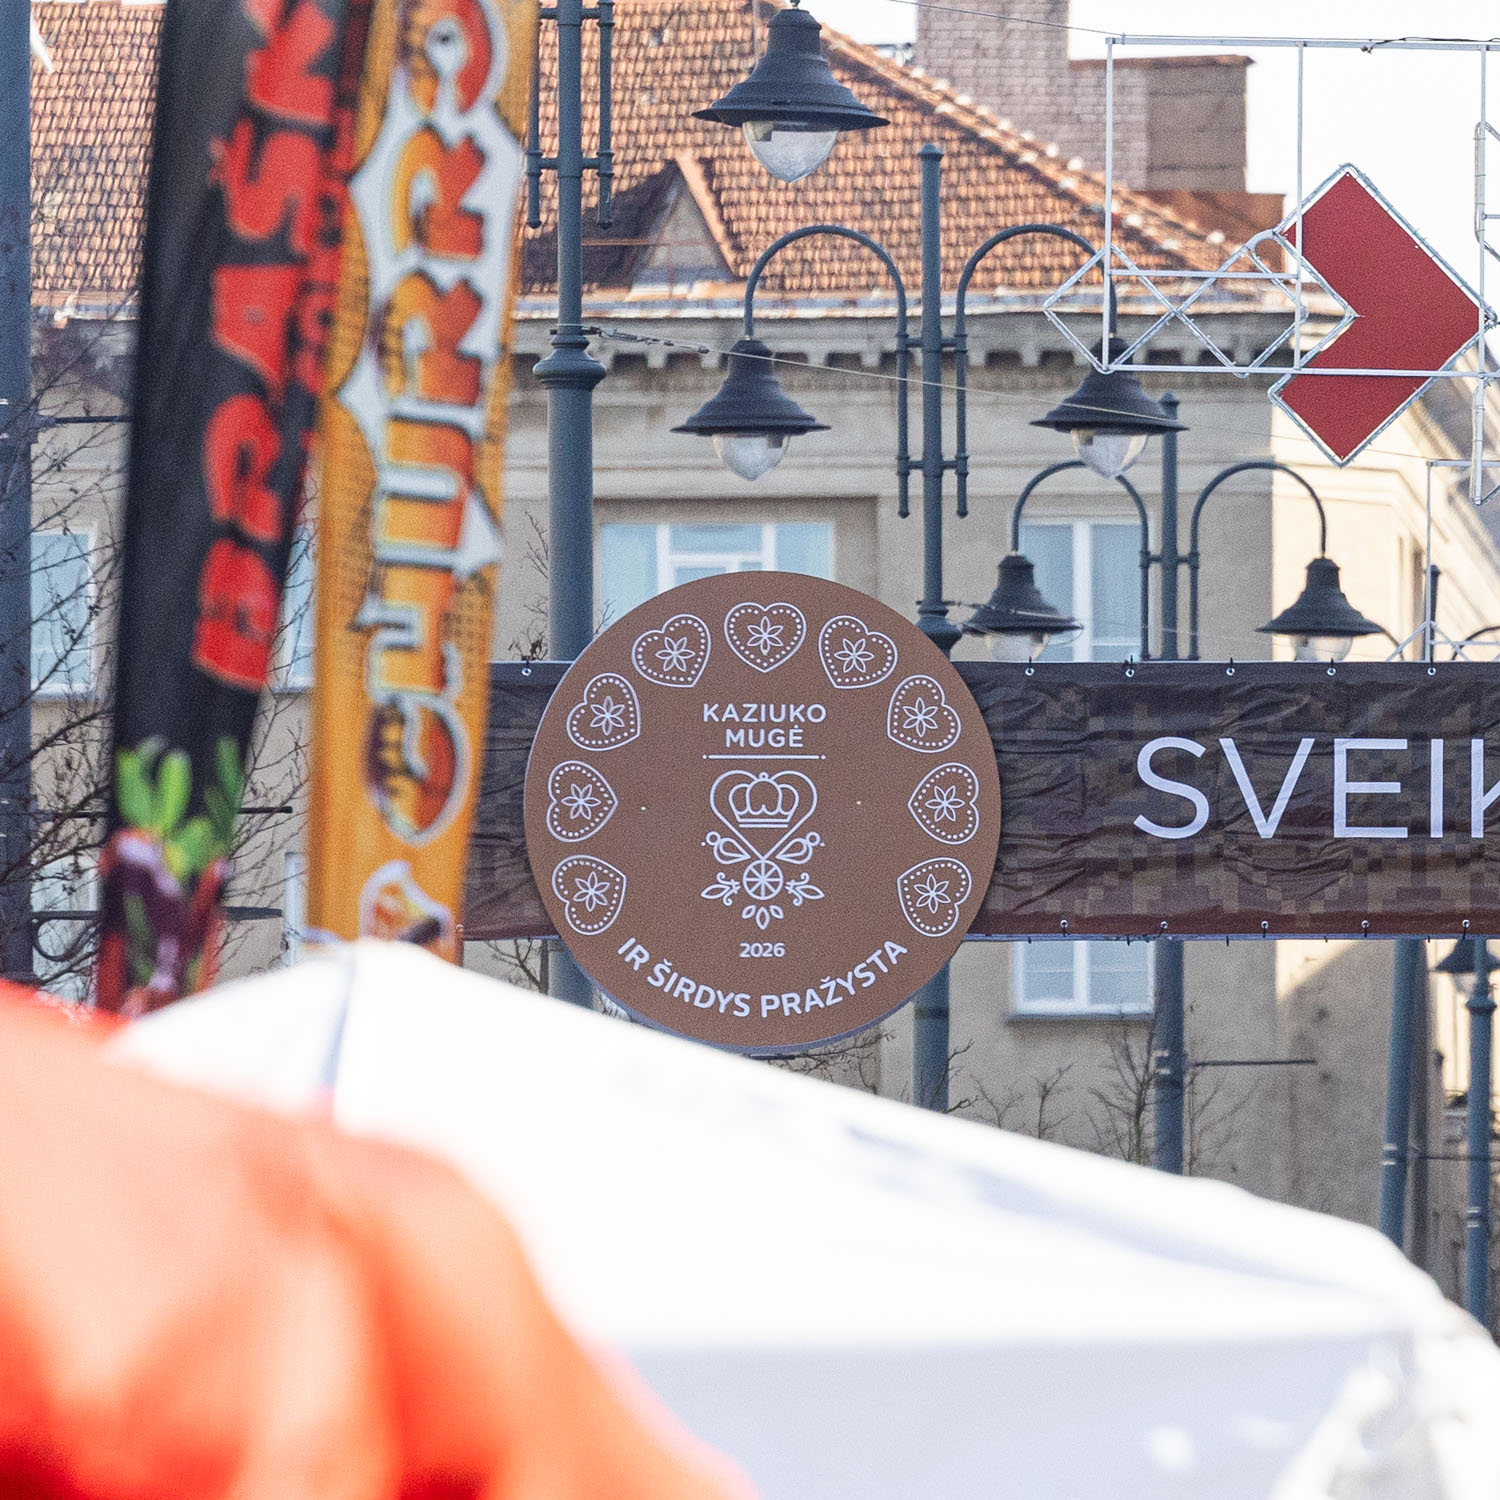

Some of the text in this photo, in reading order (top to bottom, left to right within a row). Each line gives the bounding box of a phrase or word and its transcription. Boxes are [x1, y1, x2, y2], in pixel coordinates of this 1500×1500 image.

[703, 703, 827, 724] KAZIUKO
[725, 725, 804, 748] MUGĖ
[739, 942, 786, 958] 2026
[616, 936, 908, 1018] IR ŠIRDYS PRAŽYSTA
